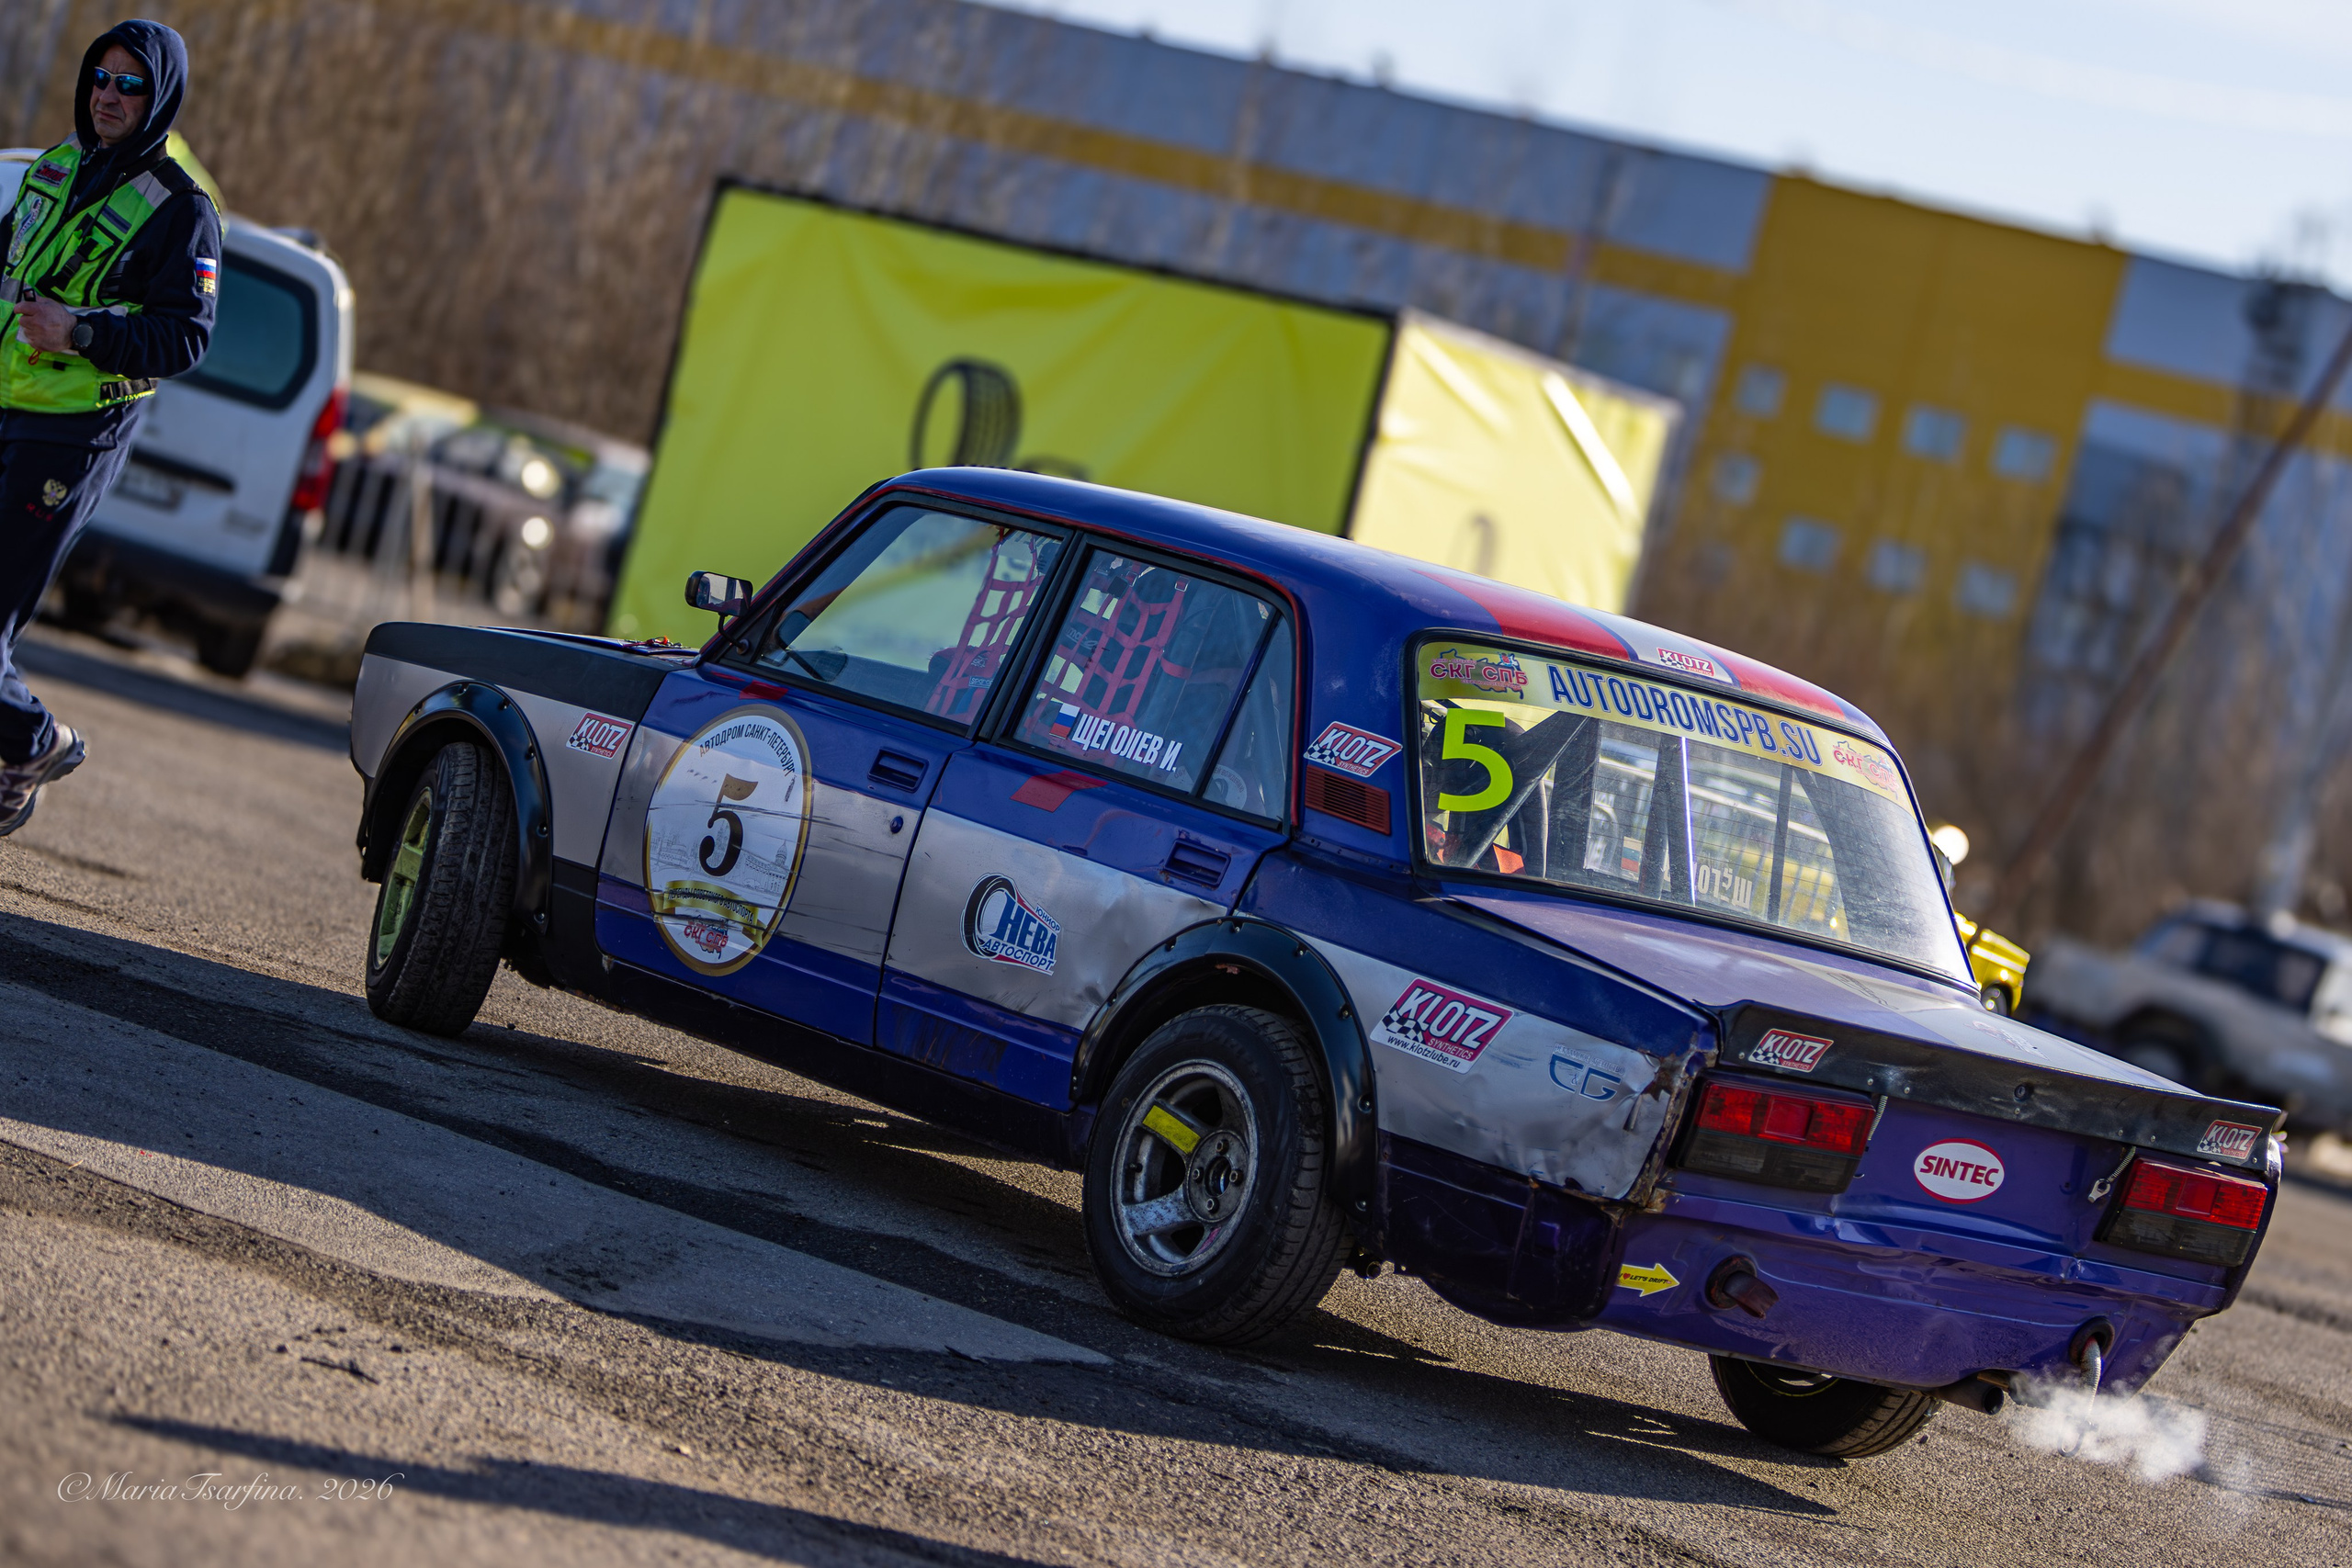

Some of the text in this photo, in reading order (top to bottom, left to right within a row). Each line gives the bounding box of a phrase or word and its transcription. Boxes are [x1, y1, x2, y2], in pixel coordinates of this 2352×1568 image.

[1430, 663, 1476, 679] СКГ
[1482, 666, 1529, 685] СПБ
[1662, 650, 1712, 672] KLOTZ
[1546, 663, 1823, 767] AUTODROMSPB.SU
[577, 717, 628, 750] KLOTZ
[1319, 728, 1394, 769] KLOTZ
[699, 723, 796, 777] АВТОДРОМ САНКТ-ПЕТЕРБУРГ
[1159, 739, 1183, 773] И.
[1438, 708, 1514, 812] 5
[1833, 750, 1863, 771] СКГ
[1337, 761, 1369, 775] SYNTHETICS
[699, 773, 759, 877] 5
[684, 924, 706, 941] СКГ
[1035, 906, 1060, 932] ЮНИОР
[982, 938, 1055, 971] АВТОСПОРТ
[1397, 987, 1504, 1051] KLOTZ
[1387, 1035, 1461, 1068] www.klotzlube.ru
[1428, 1037, 1474, 1060] SYNTHETICS
[1762, 1033, 1826, 1064] KLOTZ
[2206, 1124, 2256, 1151] KLOTZ
[1919, 1155, 1999, 1187] SINTEC
